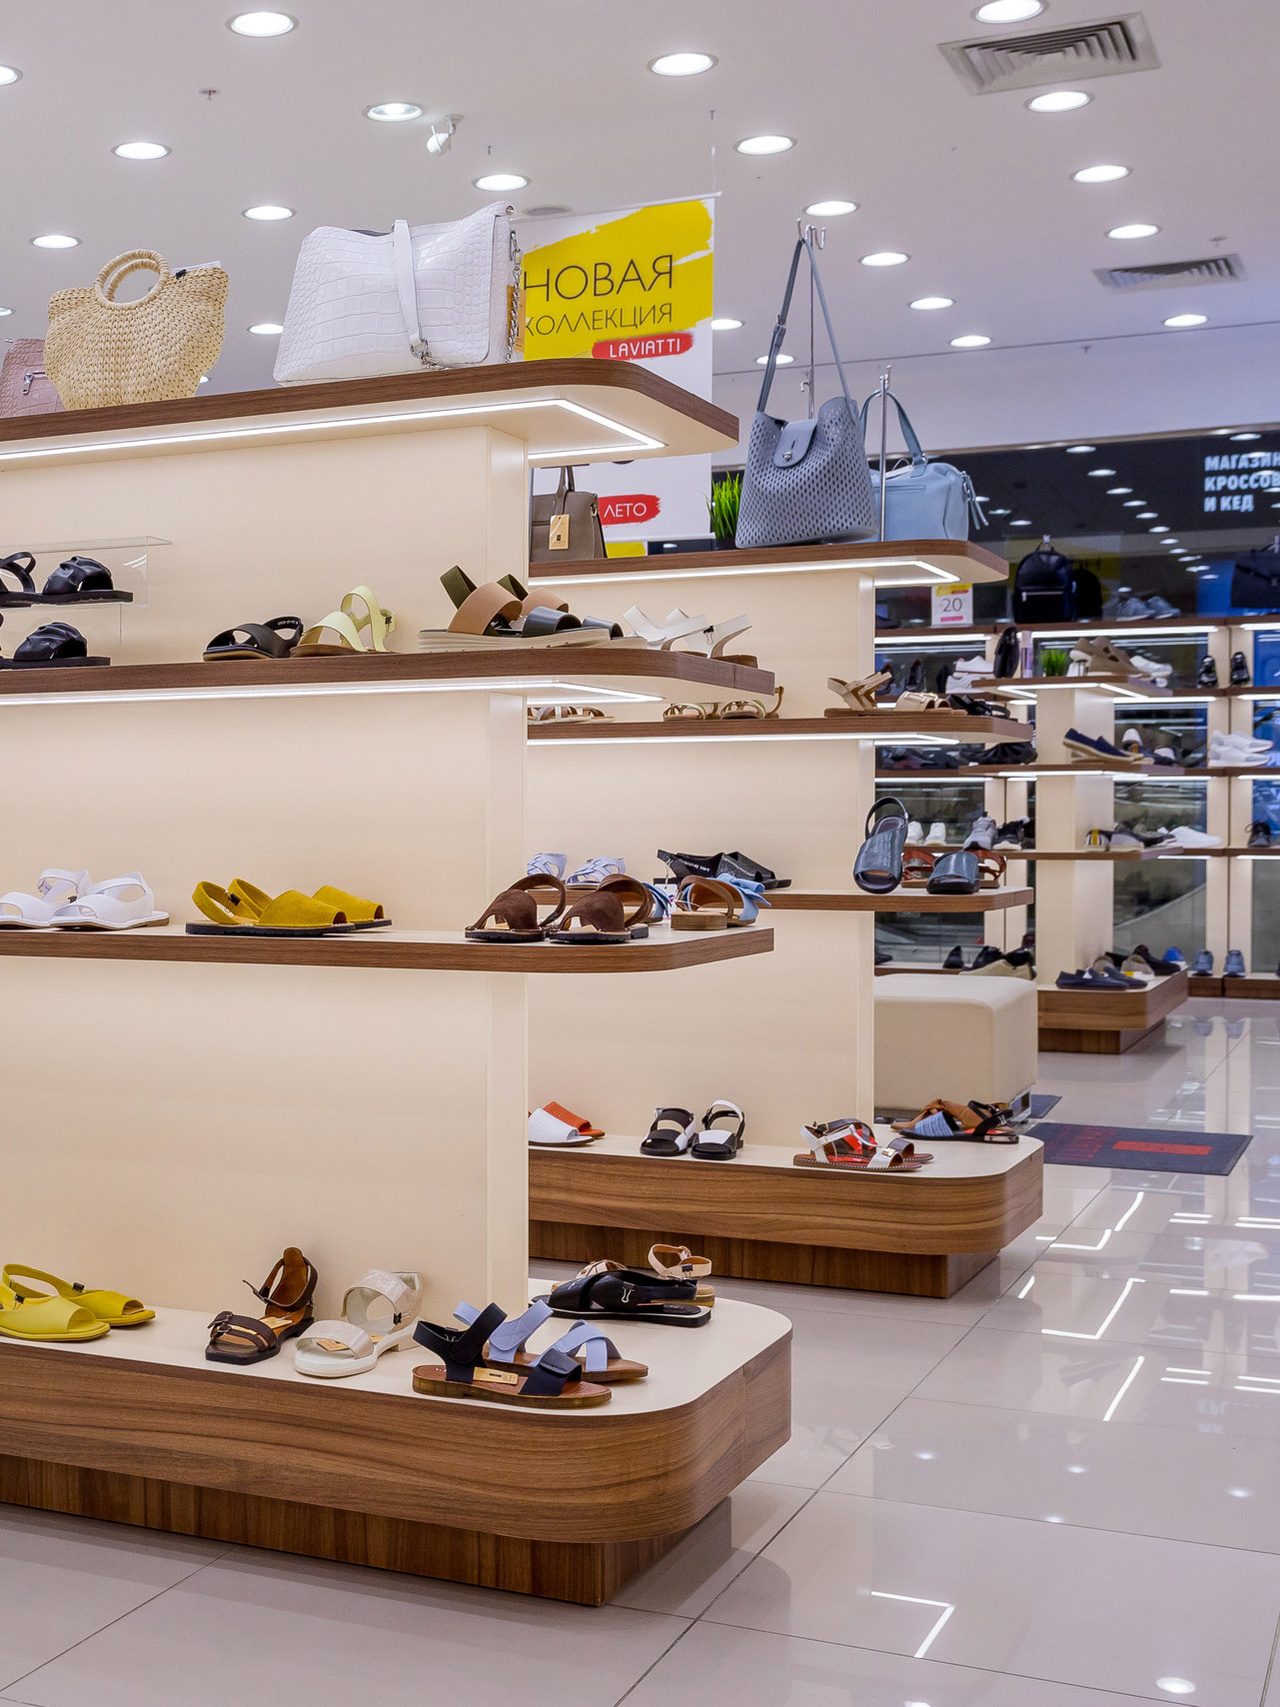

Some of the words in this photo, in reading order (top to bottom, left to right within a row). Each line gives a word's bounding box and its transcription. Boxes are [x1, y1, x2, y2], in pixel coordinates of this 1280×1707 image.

[523, 254, 673, 302] НОВАЯ
[525, 303, 673, 336] КОЛЛЕКЦИЯ
[609, 338, 681, 358] LAVIATTI
[1204, 451, 1280, 471] МАГАЗИН
[603, 502, 647, 518] ЛЕТО
[1204, 496, 1217, 512] И
[1220, 494, 1254, 513] КЕД
